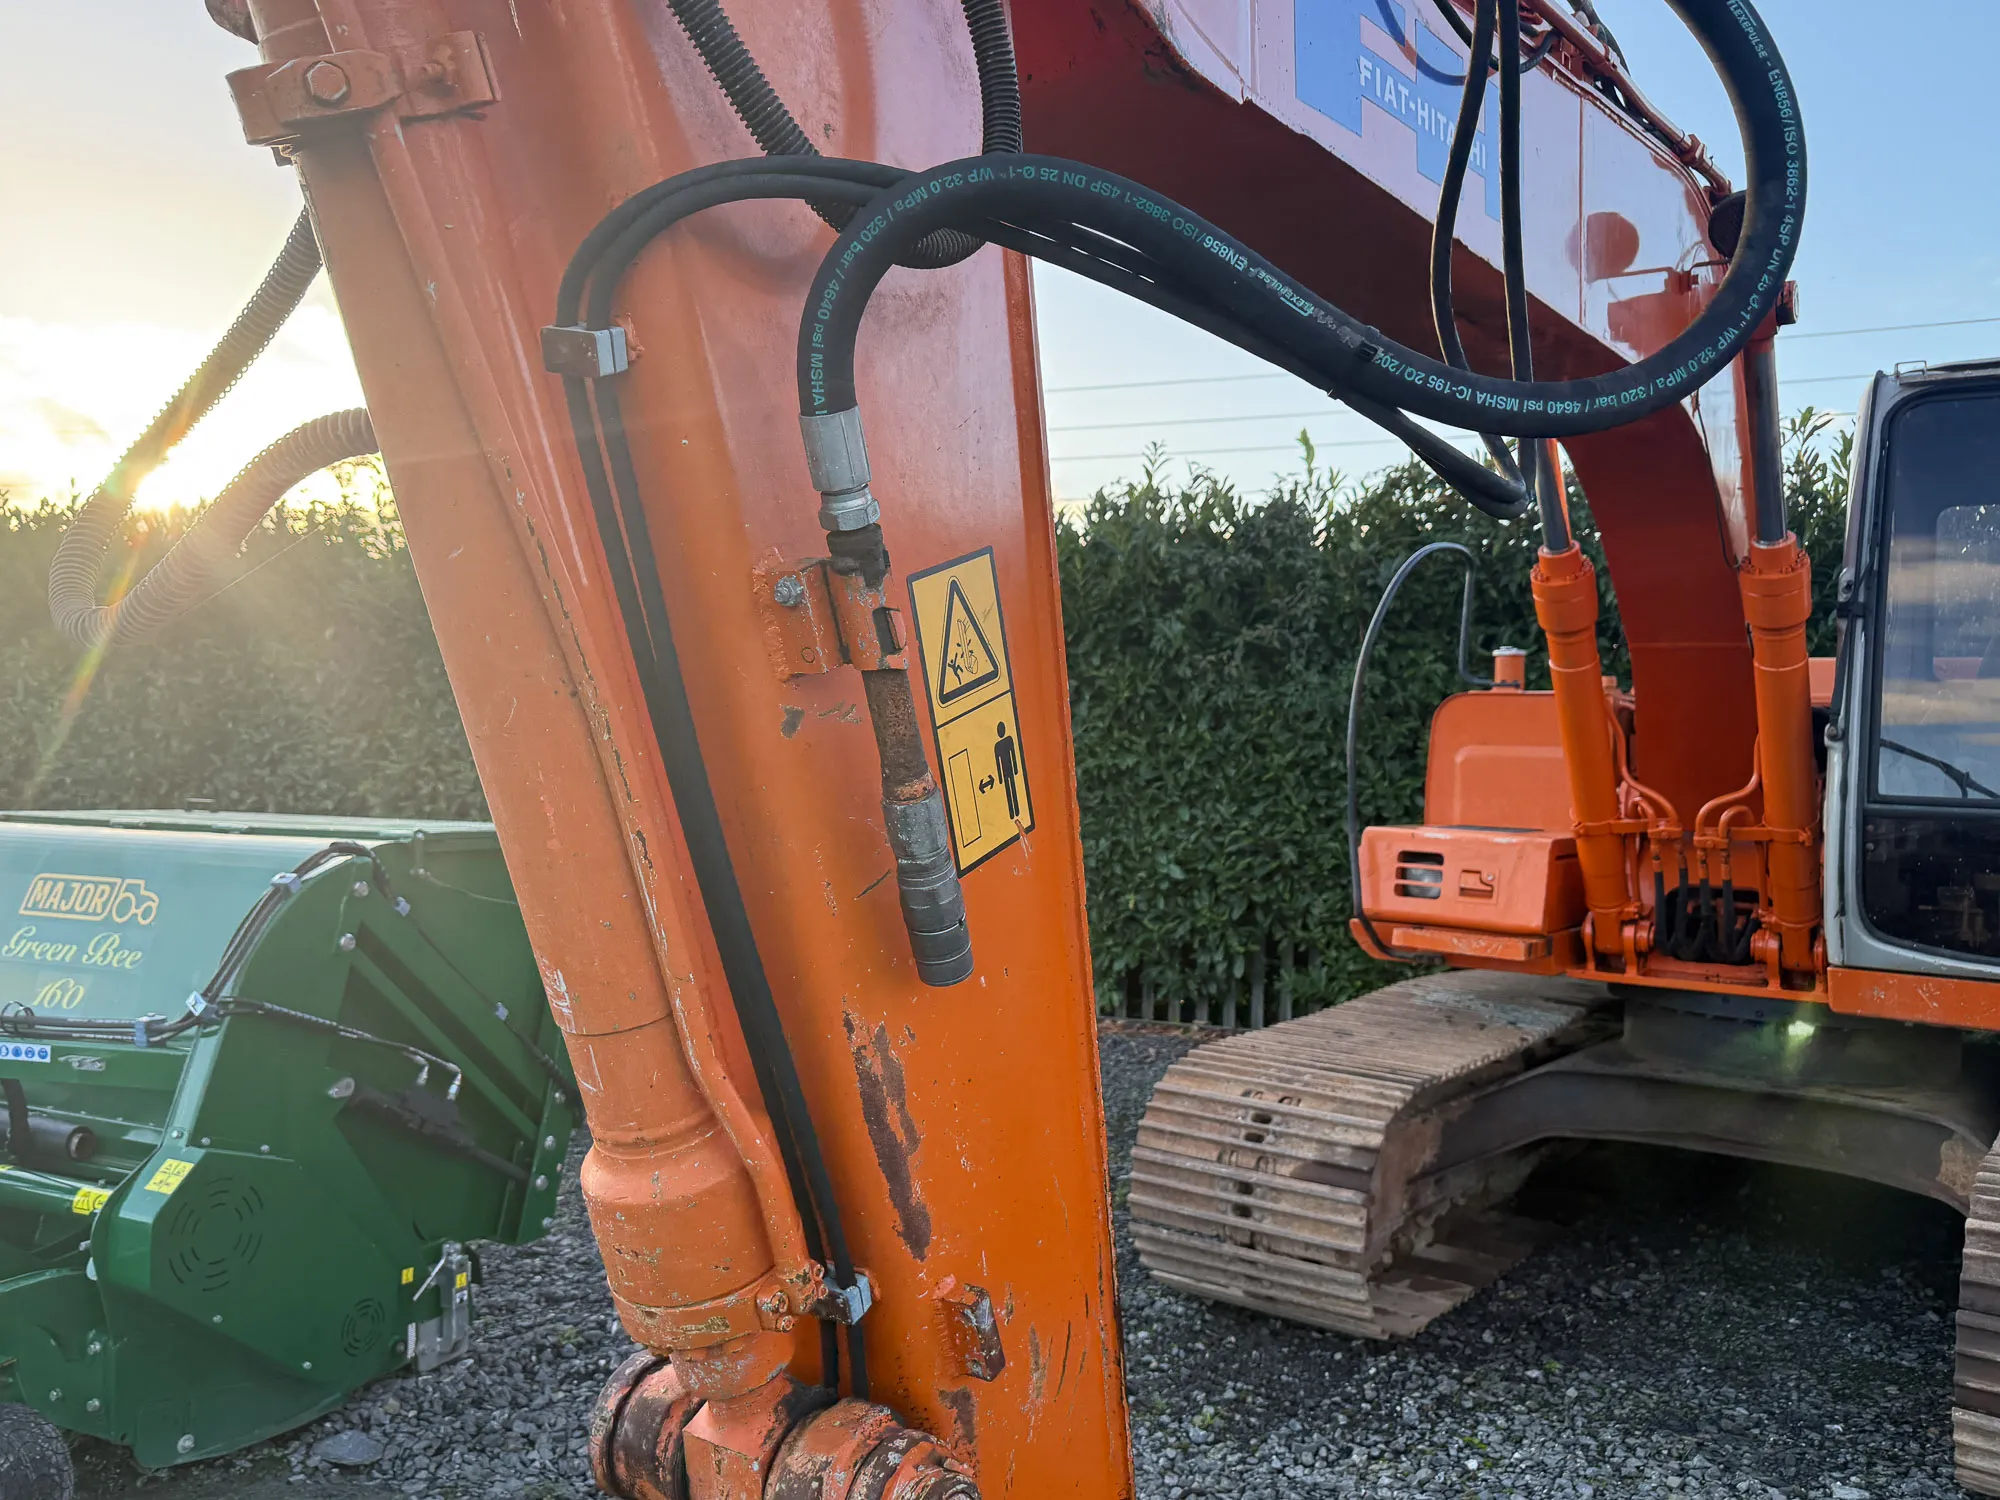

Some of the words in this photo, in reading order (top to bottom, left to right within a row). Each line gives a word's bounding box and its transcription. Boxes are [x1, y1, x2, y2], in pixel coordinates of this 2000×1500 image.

[1359, 54, 1486, 170] FIAT-HITAHI
[1768, 69, 1798, 155] EN856/ISO
[929, 173, 963, 194] 32.0
[967, 167, 994, 183] WP
[1040, 167, 1059, 181] 25
[1062, 171, 1087, 188] DN
[1784, 159, 1799, 210] 3862-1
[894, 186, 928, 211] MPa
[1090, 180, 1121, 199] 4SP
[1123, 191, 1171, 223] 3862-1
[860, 215, 887, 242] 320
[1779, 214, 1795, 246] 4SP
[841, 241, 864, 269] bar
[1172, 217, 1249, 272] EN856/ISO
[1767, 248, 1783, 273] DN
[817, 279, 840, 320] 4640
[812, 323, 824, 348] psi
[1717, 327, 1739, 349] WP
[1687, 346, 1716, 372] 32.0
[810, 353, 826, 406] MSHA
[1426, 375, 1472, 401] IC-195
[1655, 366, 1688, 388] MPa
[1476, 391, 1519, 412] MSHA
[1522, 399, 1544, 413] psi
[1546, 400, 1581, 414] 4640
[1593, 395, 1618, 409] bar
[1620, 386, 1646, 404] 320
[27, 879, 111, 914] MAJOR
[2, 925, 78, 963] Green
[82, 931, 143, 970] Bee
[32, 977, 85, 1010] 160
